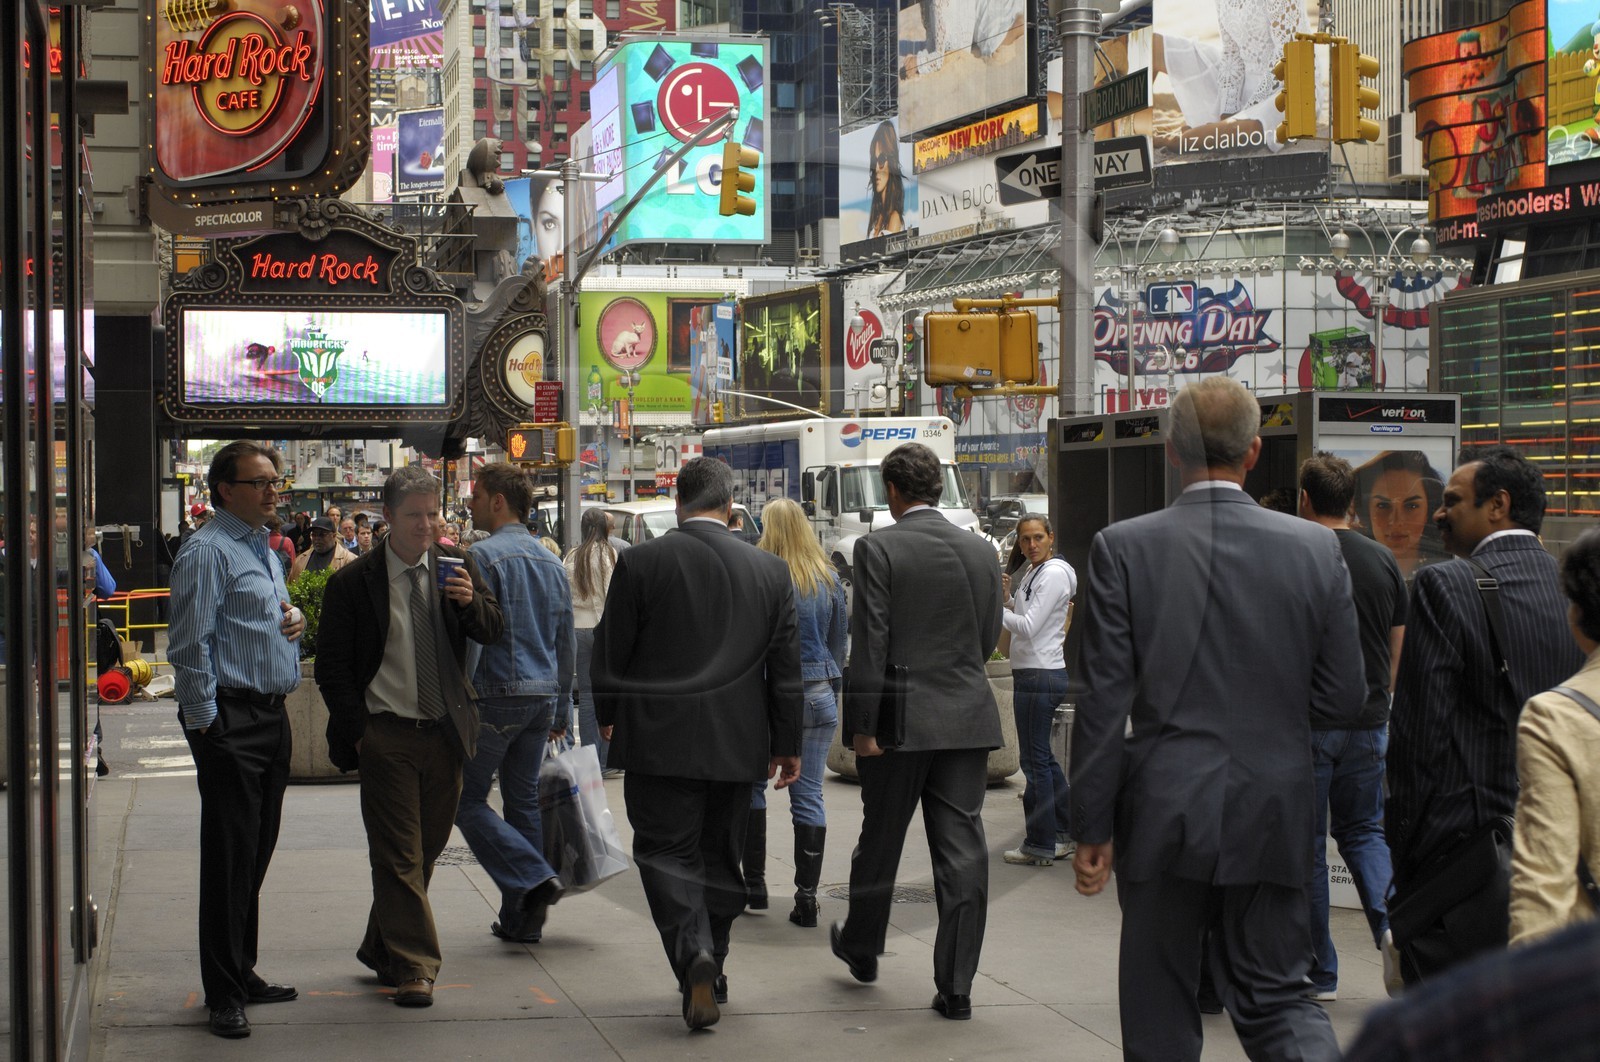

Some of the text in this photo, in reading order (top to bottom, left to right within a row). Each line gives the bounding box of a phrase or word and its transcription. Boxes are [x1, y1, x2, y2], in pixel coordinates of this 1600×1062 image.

[626, 0, 666, 31] Va
[162, 30, 312, 85] Hard Rock
[216, 90, 260, 111] CAFE
[1096, 75, 1146, 121] BROADWAY
[918, 118, 1005, 153] WELCOME TO NEW YORK
[1179, 125, 1297, 155] liz claibor
[665, 154, 722, 196] LG
[1019, 153, 1130, 187] ONE WAY
[922, 192, 959, 219] DANA
[1580, 182, 1600, 207] W
[195, 210, 263, 227] SPECTACOLOR
[251, 253, 379, 285] Hard Rock
[1094, 306, 1263, 347] OPENING DAY
[850, 322, 875, 364] Virgin
[872, 346, 896, 358] moe
[508, 358, 535, 372] Hard
[1381, 406, 1426, 420] verizon
[860, 427, 917, 440] PEPSI
[922, 430, 942, 438] 13346
[277, 493, 292, 504] TM
[1331, 865, 1351, 874] STA
